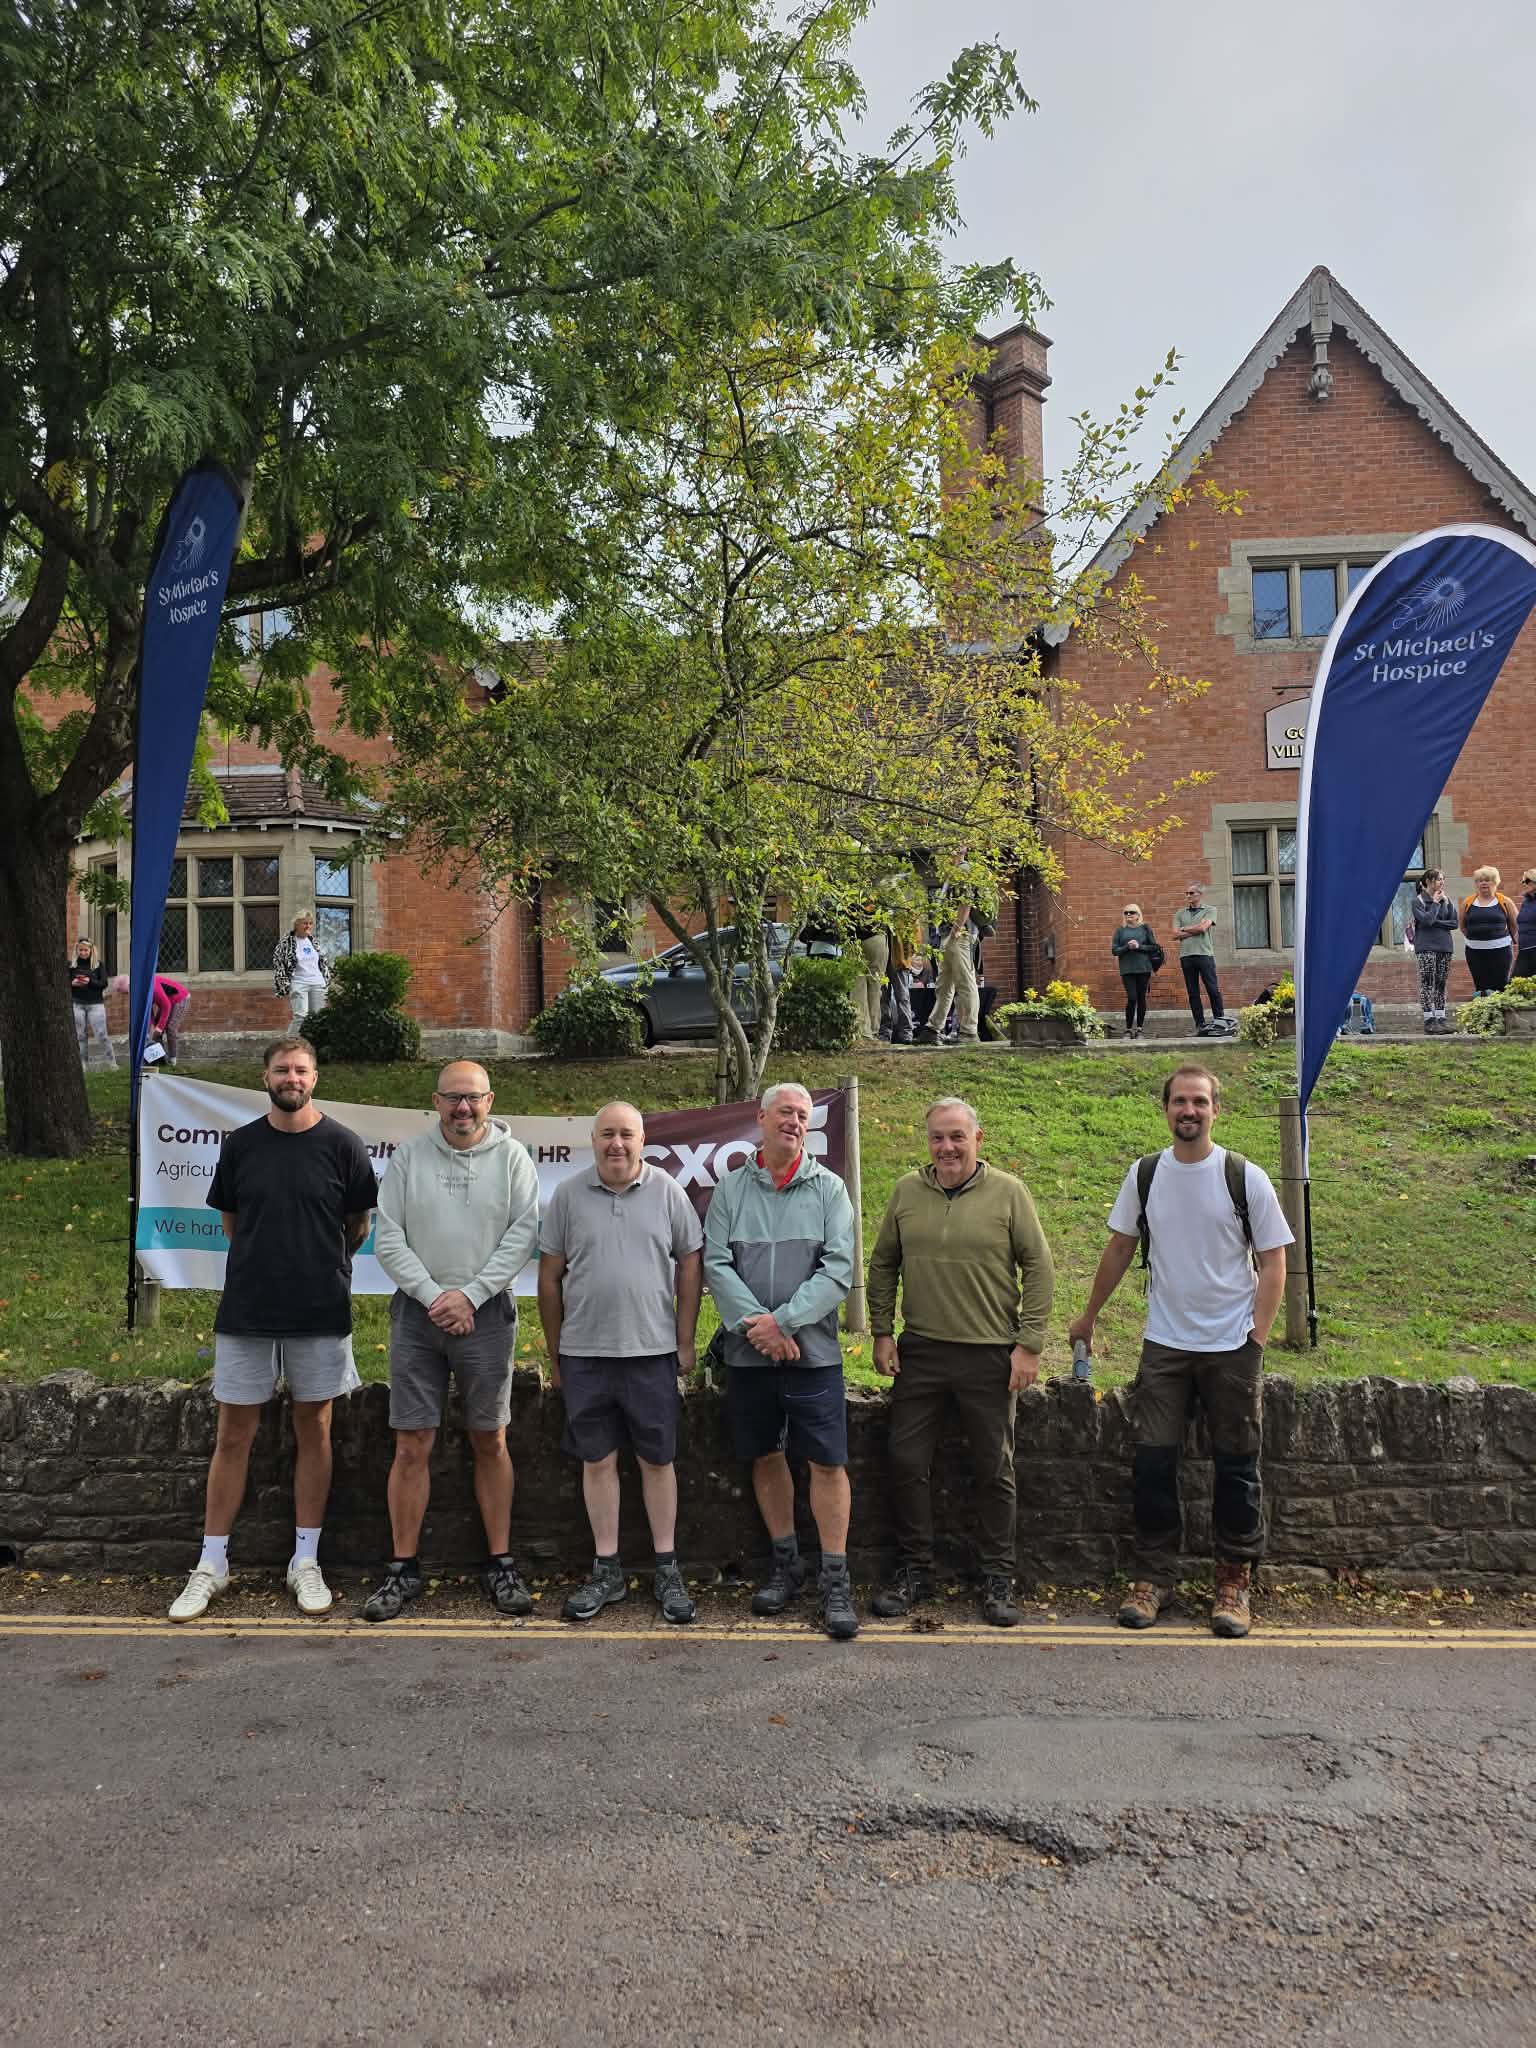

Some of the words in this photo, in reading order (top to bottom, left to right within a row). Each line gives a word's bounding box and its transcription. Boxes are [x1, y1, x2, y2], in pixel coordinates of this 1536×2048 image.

[1353, 643, 1376, 661] St
[1382, 629, 1496, 659] Michael's
[1372, 659, 1468, 684] Hospice
[538, 1145, 571, 1163] HR
[155, 1218, 186, 1234] We
